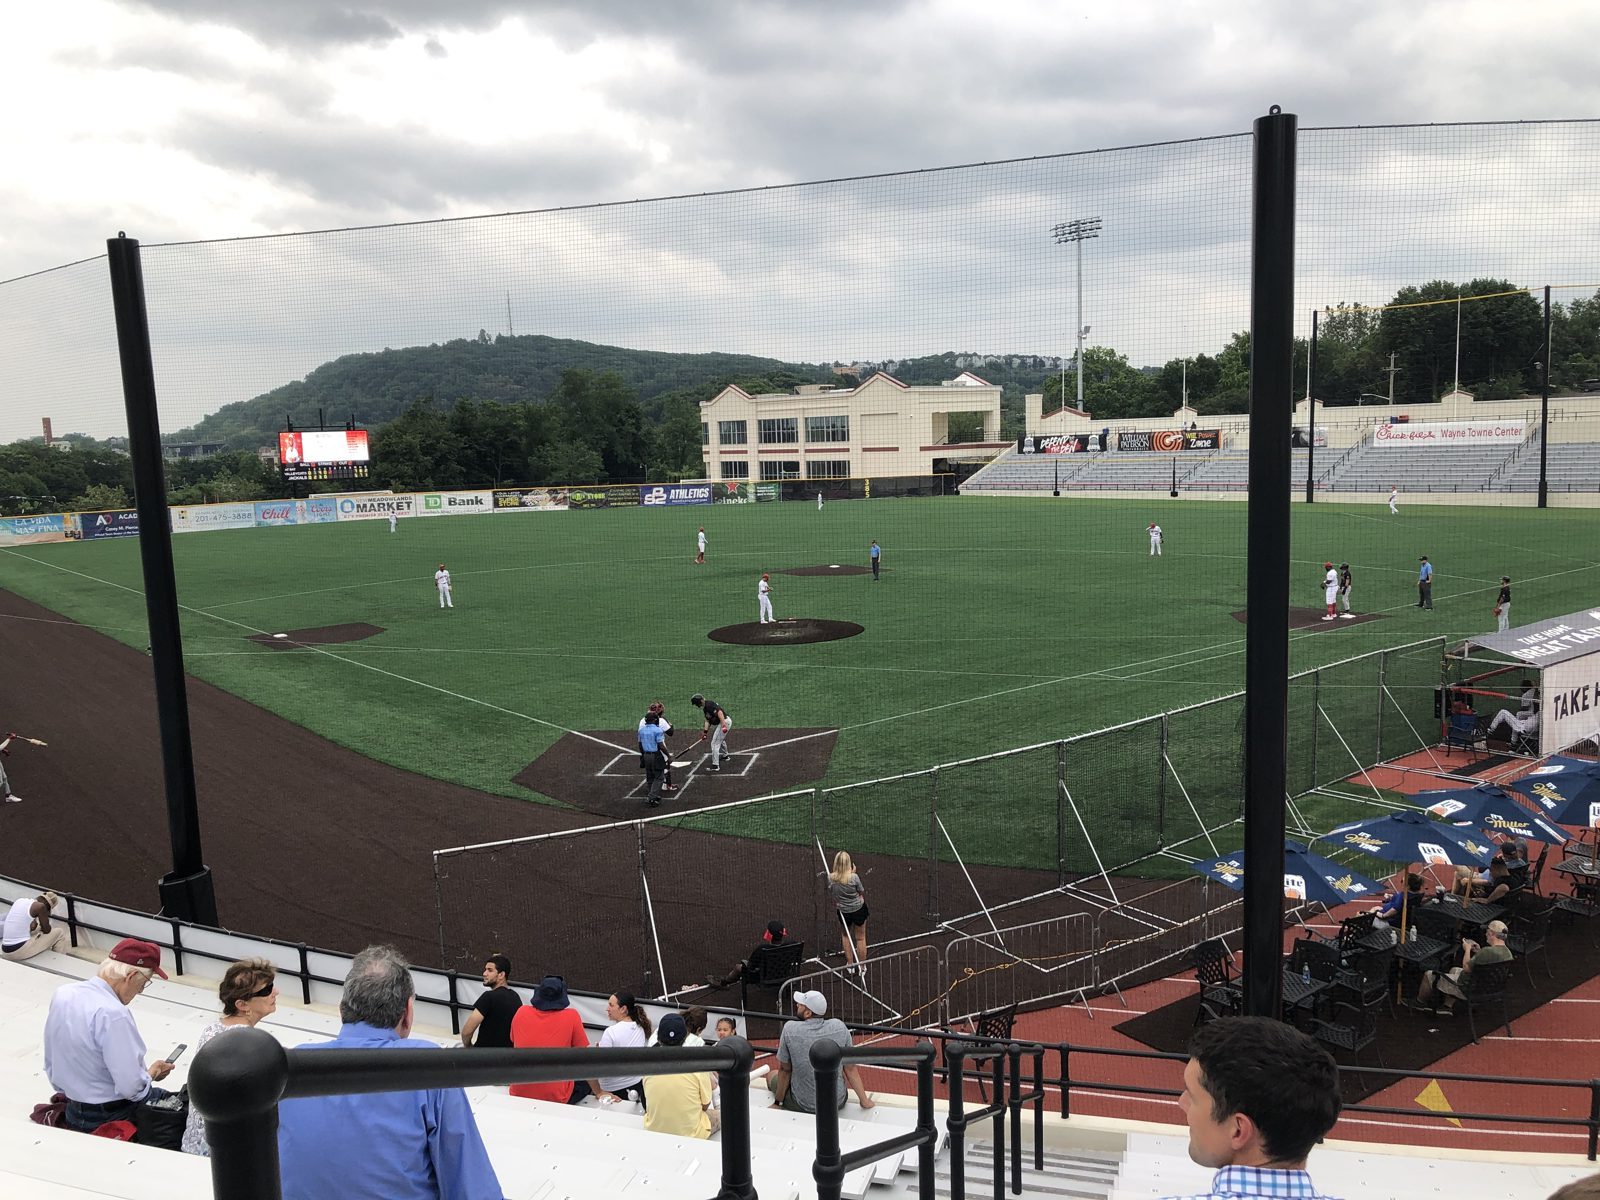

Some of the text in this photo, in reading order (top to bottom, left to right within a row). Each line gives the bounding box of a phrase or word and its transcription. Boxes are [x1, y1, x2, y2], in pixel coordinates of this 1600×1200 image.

[1121, 433, 1149, 441] WILLIAM
[1441, 428, 1466, 439] Wayne
[1467, 427, 1493, 437] Towne
[1494, 426, 1522, 437] Center
[1040, 435, 1070, 450] DEFEND
[1060, 438, 1079, 454] DEN
[1120, 440, 1150, 448] PATERSON
[1190, 438, 1212, 448] Zone
[669, 488, 710, 500] ATHLETICS
[356, 501, 413, 513] MARKET
[425, 495, 484, 507] TD Bank
[262, 507, 291, 520] Chill
[15, 516, 51, 526] LA VIDA
[38, 524, 60, 532] FINA
[1510, 639, 1573, 659] GREAT
[1553, 684, 1590, 722] TAKE
[1484, 816, 1530, 829] Miller
[1508, 826, 1535, 837] TIME
